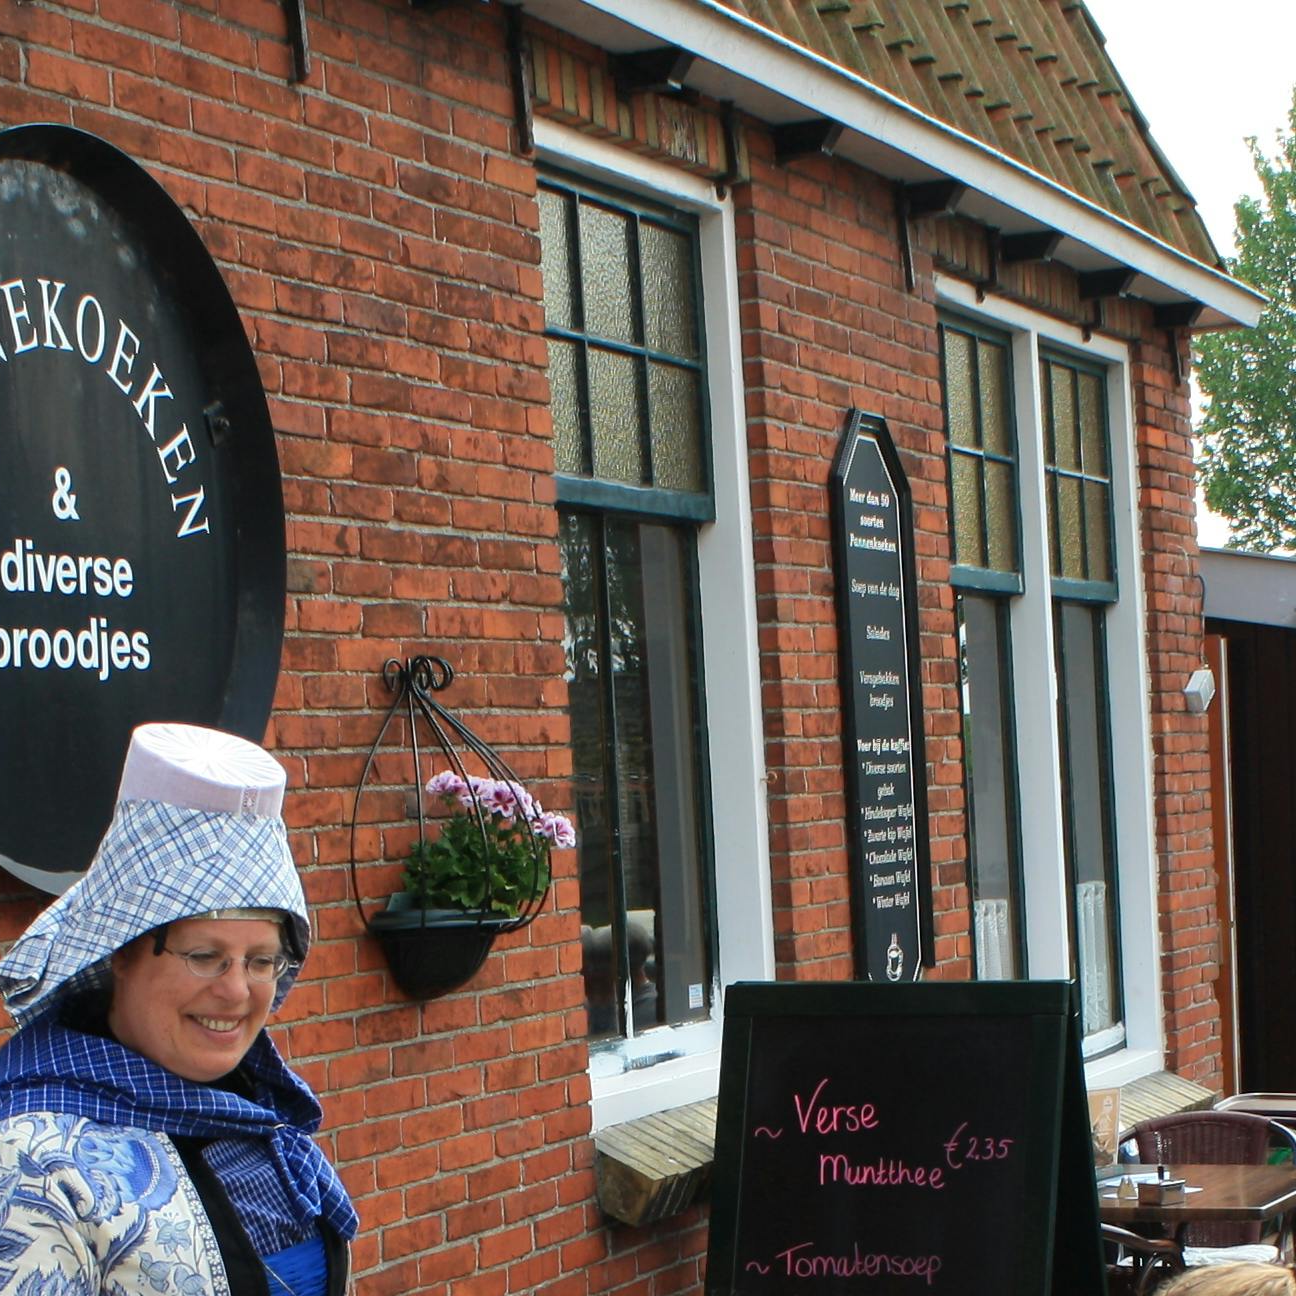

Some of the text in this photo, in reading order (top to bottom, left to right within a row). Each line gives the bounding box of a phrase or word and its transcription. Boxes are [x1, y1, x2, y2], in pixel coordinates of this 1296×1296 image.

[52, 466, 80, 521] &
[849, 487, 890, 508] Meer dan 50
[859, 515, 884, 529] soorten
[0, 538, 134, 598] diverse
[851, 578, 900, 601] Soep van de dag
[869, 693, 894, 711] broodjes
[872, 738, 881, 756] bij
[881, 738, 890, 752] de
[793, 1077, 880, 1136] Verse
[818, 1153, 946, 1191] Muntthee
[775, 1241, 942, 1286] Tomatensoep
